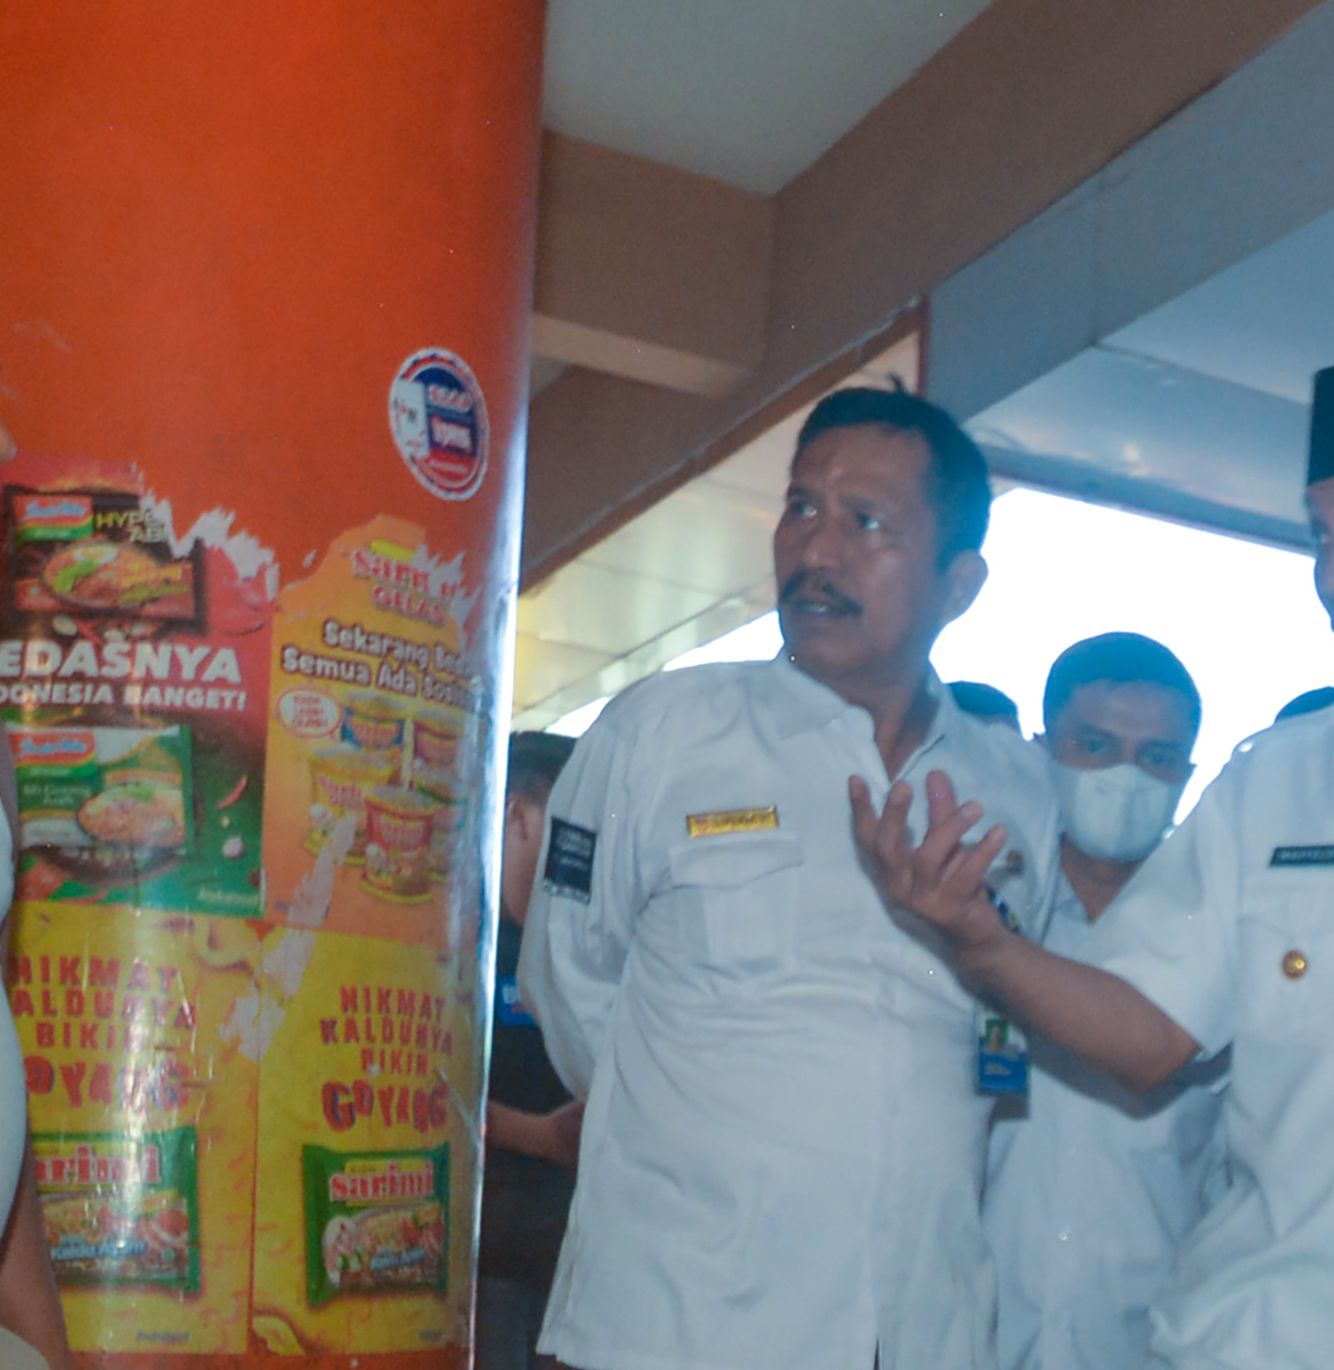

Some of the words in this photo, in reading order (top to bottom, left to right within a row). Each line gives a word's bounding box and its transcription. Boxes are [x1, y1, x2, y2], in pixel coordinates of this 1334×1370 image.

[324, 619, 428, 671] Sekarang
[282, 646, 370, 685] Semua
[377, 661, 417, 695] Ada
[124, 685, 246, 711] BANGET!
[340, 985, 446, 1022] NIKMAT
[320, 1016, 453, 1057] KALDUNYA
[361, 1047, 429, 1077] BIKIN
[321, 1078, 450, 1134] GOYANG
